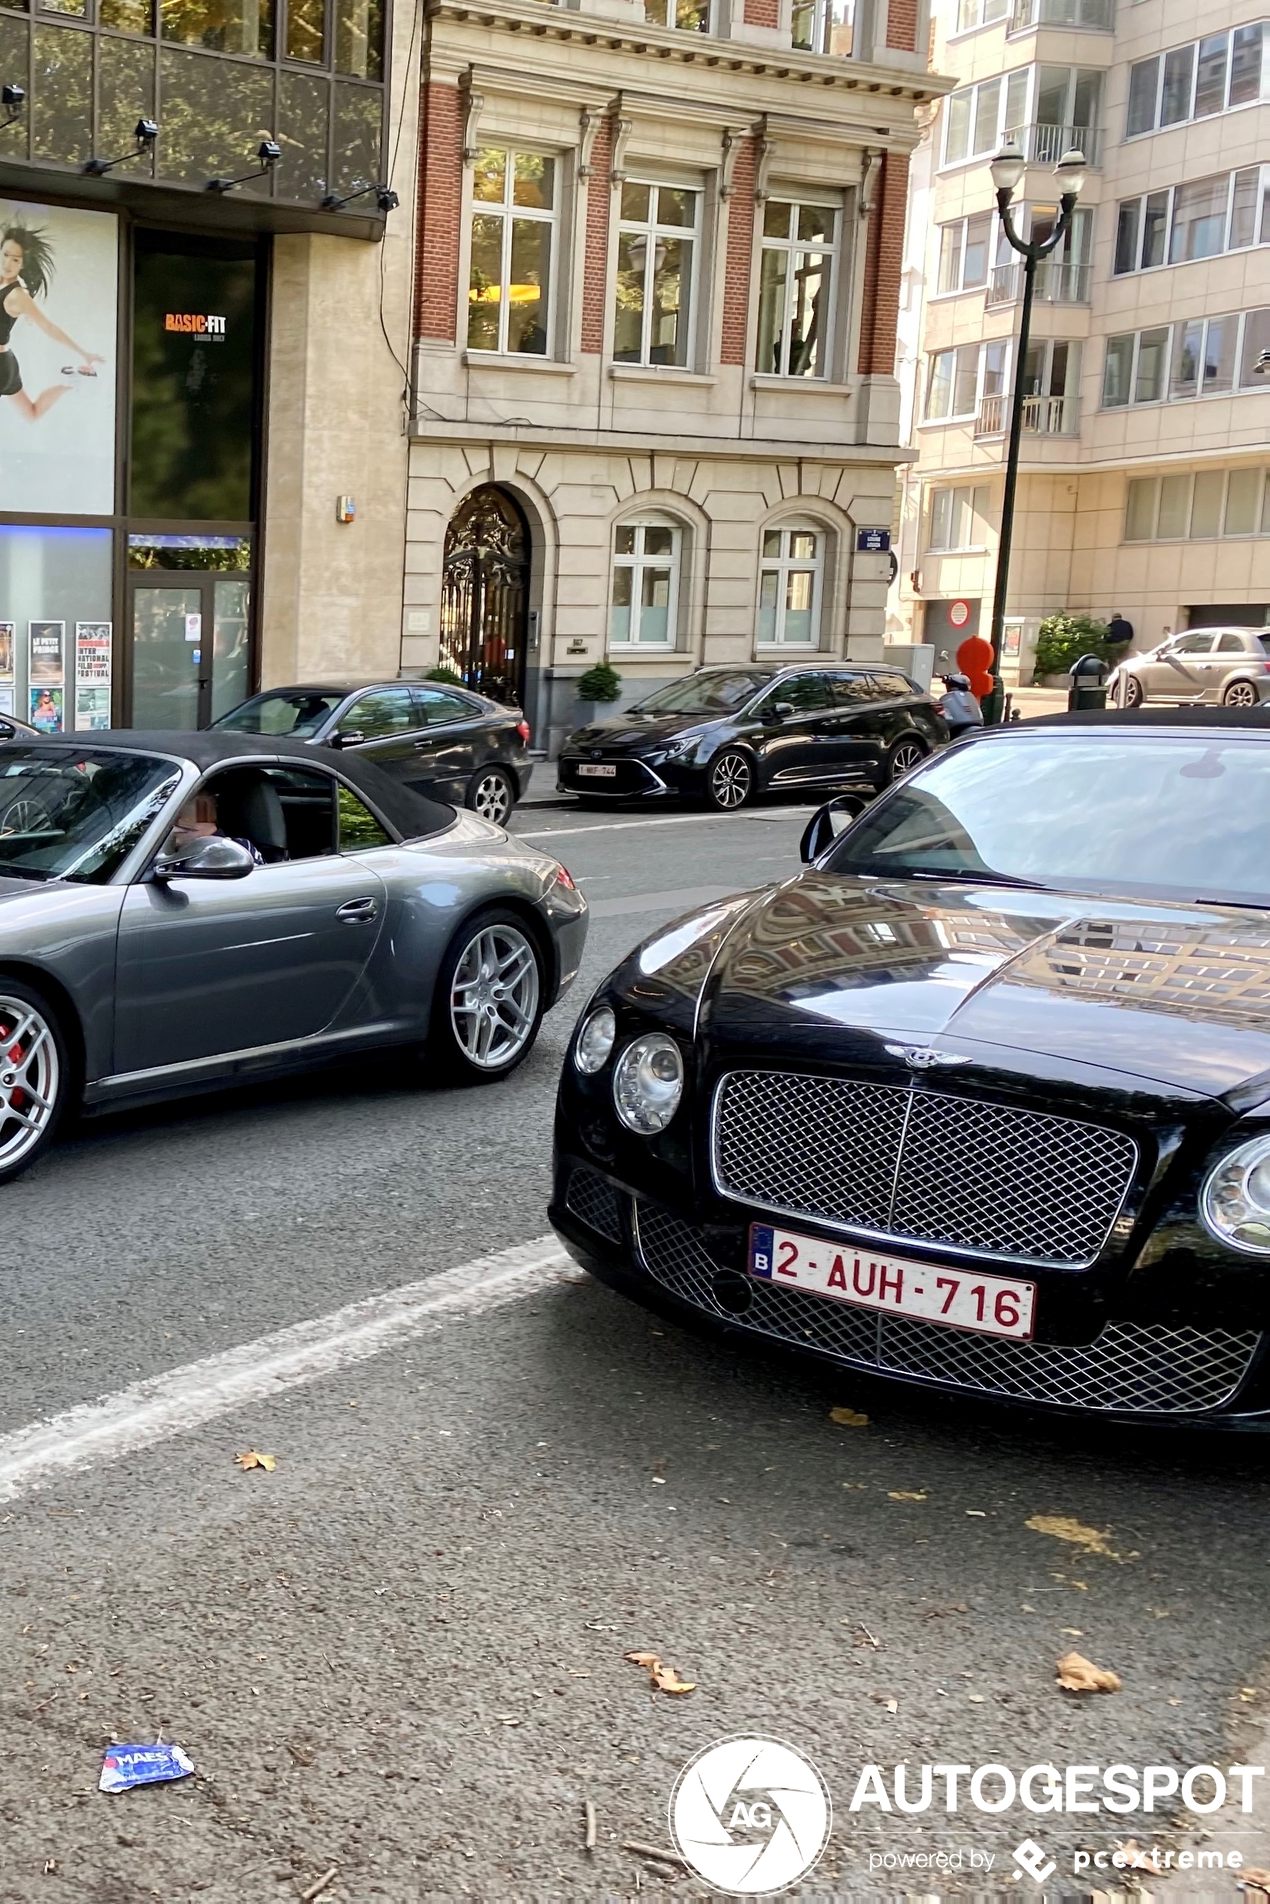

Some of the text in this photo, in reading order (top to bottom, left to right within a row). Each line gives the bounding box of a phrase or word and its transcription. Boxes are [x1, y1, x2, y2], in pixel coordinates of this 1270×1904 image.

[33, 645, 59, 654] PRINCE
[754, 1252, 769, 1271] B
[777, 1241, 1021, 1328] 2-AUH-716
[116, 1752, 169, 1766] MAES
